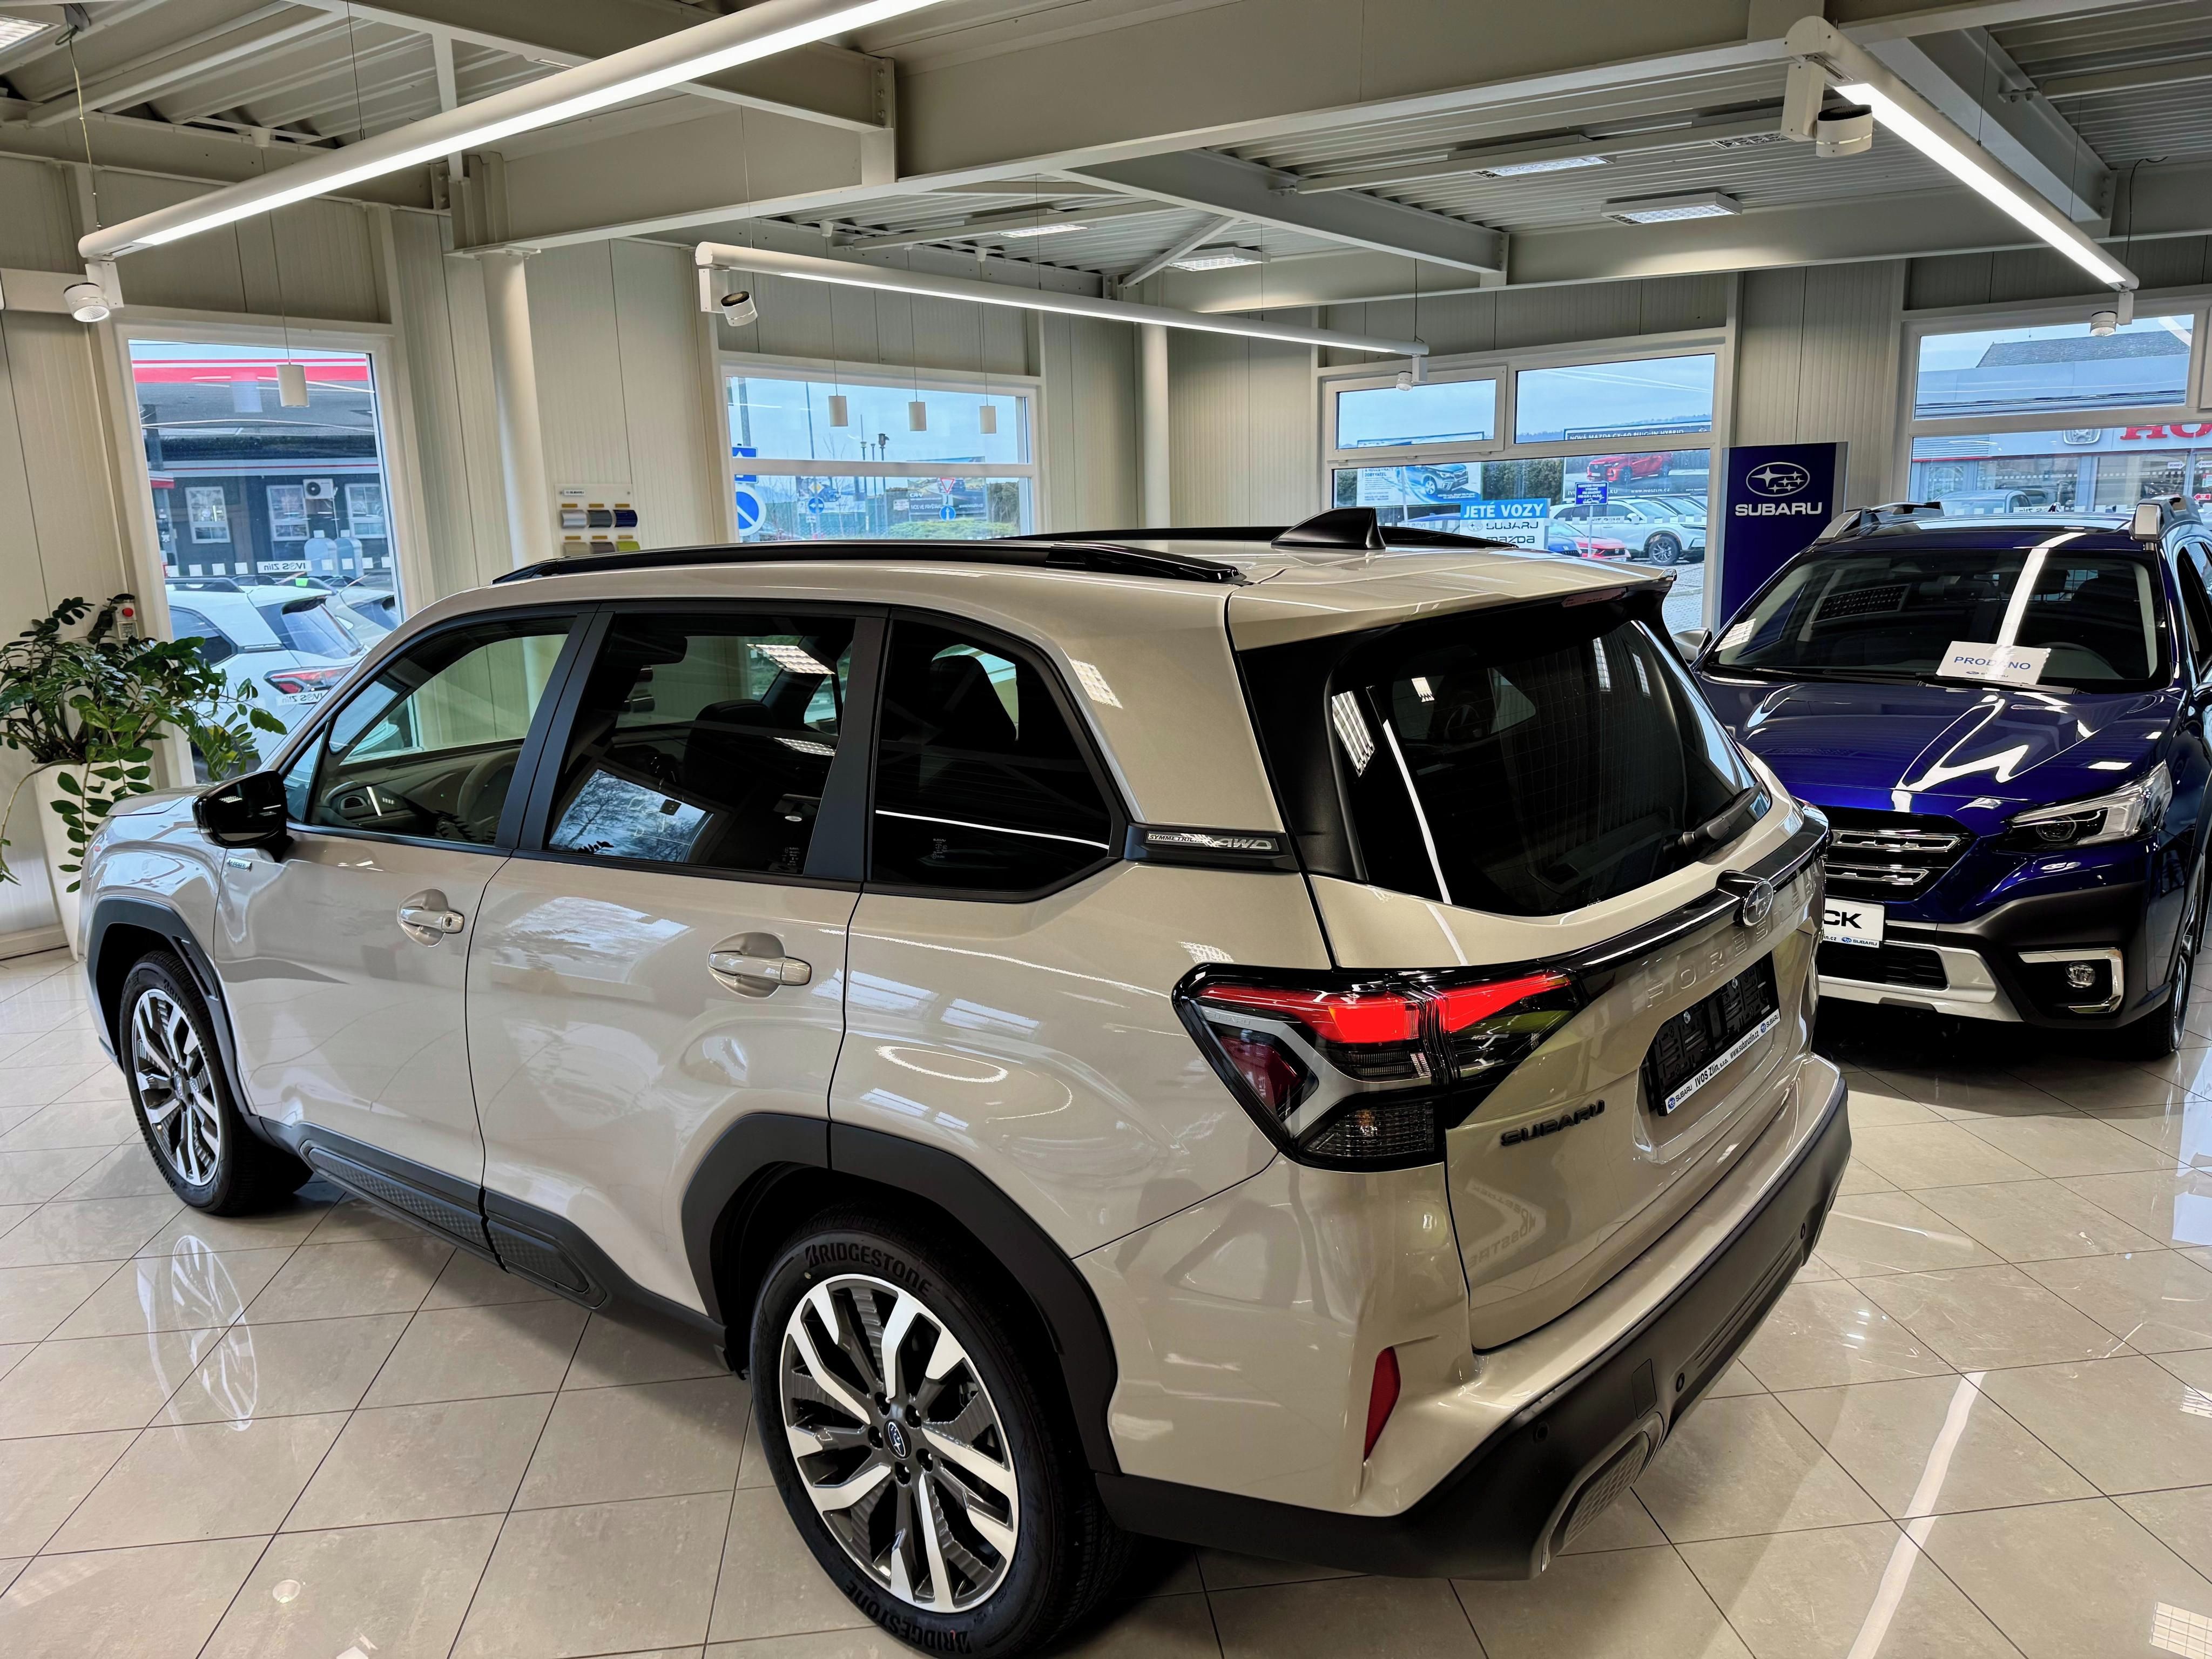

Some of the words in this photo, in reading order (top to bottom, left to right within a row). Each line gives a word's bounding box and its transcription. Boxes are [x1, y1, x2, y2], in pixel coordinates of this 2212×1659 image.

[1464, 502, 1495, 518] JETÉ
[1501, 503, 1544, 517] VOZY
[1735, 502, 1823, 516] SUBARU
[1218, 838, 1272, 850] AWD
[1675, 1084, 1693, 1102] SUBARU
[1695, 1070, 1709, 1087] IVOS
[1766, 1014, 1779, 1028] SUBARU
[1501, 1100, 1606, 1147] SUBARU
[805, 1242, 933, 1295] BRIDGESTONE
[843, 1580, 973, 1655] BRIDGESTONE
